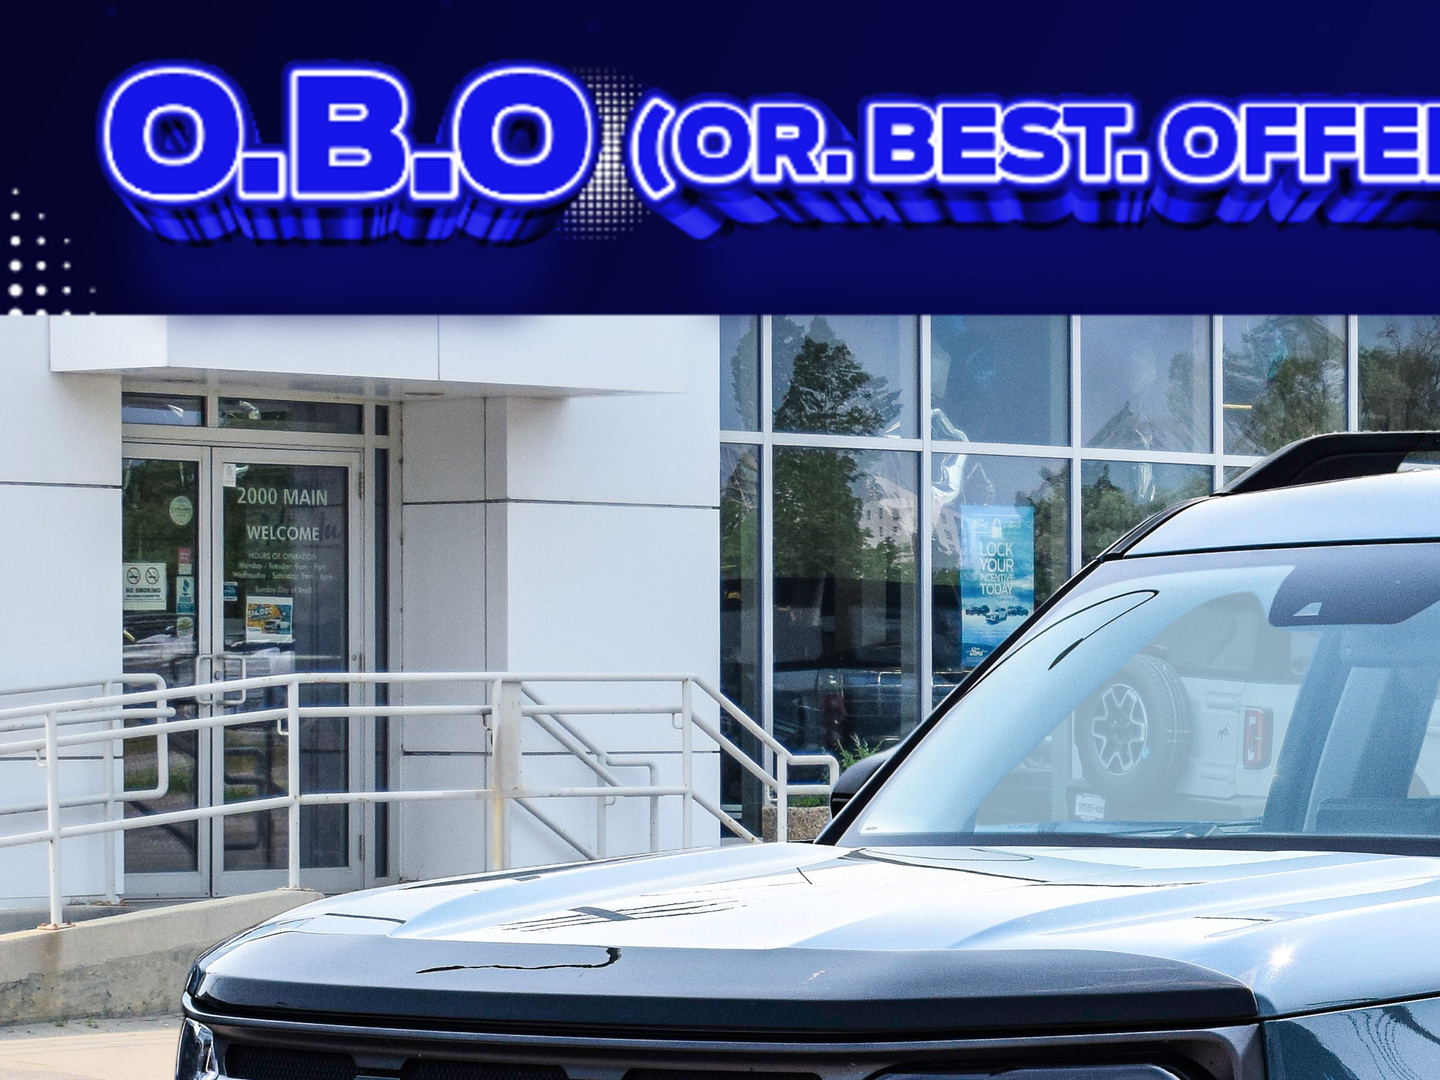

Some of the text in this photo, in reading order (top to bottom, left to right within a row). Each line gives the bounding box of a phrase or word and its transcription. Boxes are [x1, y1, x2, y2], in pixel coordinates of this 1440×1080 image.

[237, 487, 328, 506] 2000 MAIN
[246, 525, 320, 541] WELCOME
[980, 541, 1014, 557] LOCK
[980, 558, 1014, 573] YOUR
[980, 573, 1014, 582] INCENTIVE
[980, 583, 1013, 595] TODAY
